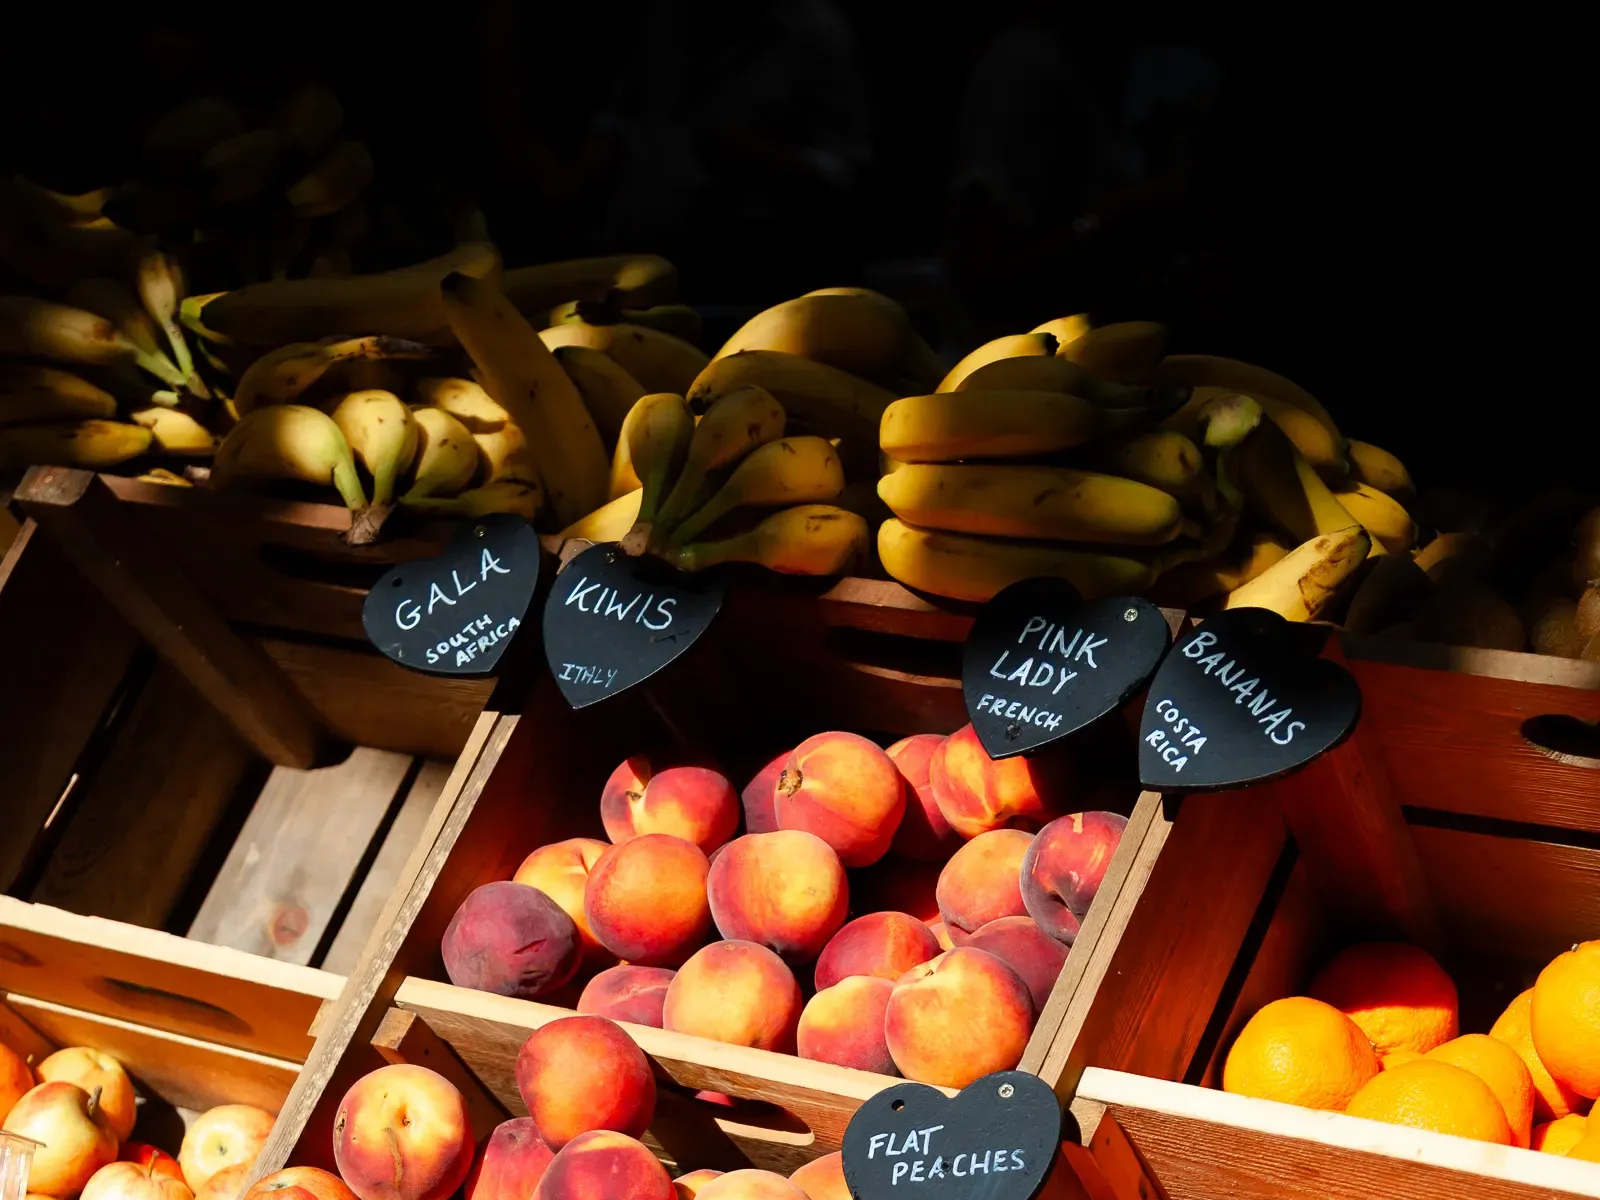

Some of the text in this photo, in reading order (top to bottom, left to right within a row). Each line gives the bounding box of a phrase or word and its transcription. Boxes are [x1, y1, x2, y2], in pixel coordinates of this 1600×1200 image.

[396, 548, 510, 630] GALA
[565, 576, 677, 630] KIWIS
[426, 614, 493, 664] SOUTH
[455, 616, 521, 667] AFRICA
[1018, 616, 1108, 668] PINK
[989, 650, 1078, 695] LADY
[1182, 631, 1306, 746] BANANAS
[976, 693, 1063, 732] FRENCH
[1155, 699, 1208, 756] COSTA
[1145, 728, 1189, 773] RICA
[867, 1125, 944, 1159] FLAT
[891, 1148, 1026, 1185] PEACHES
